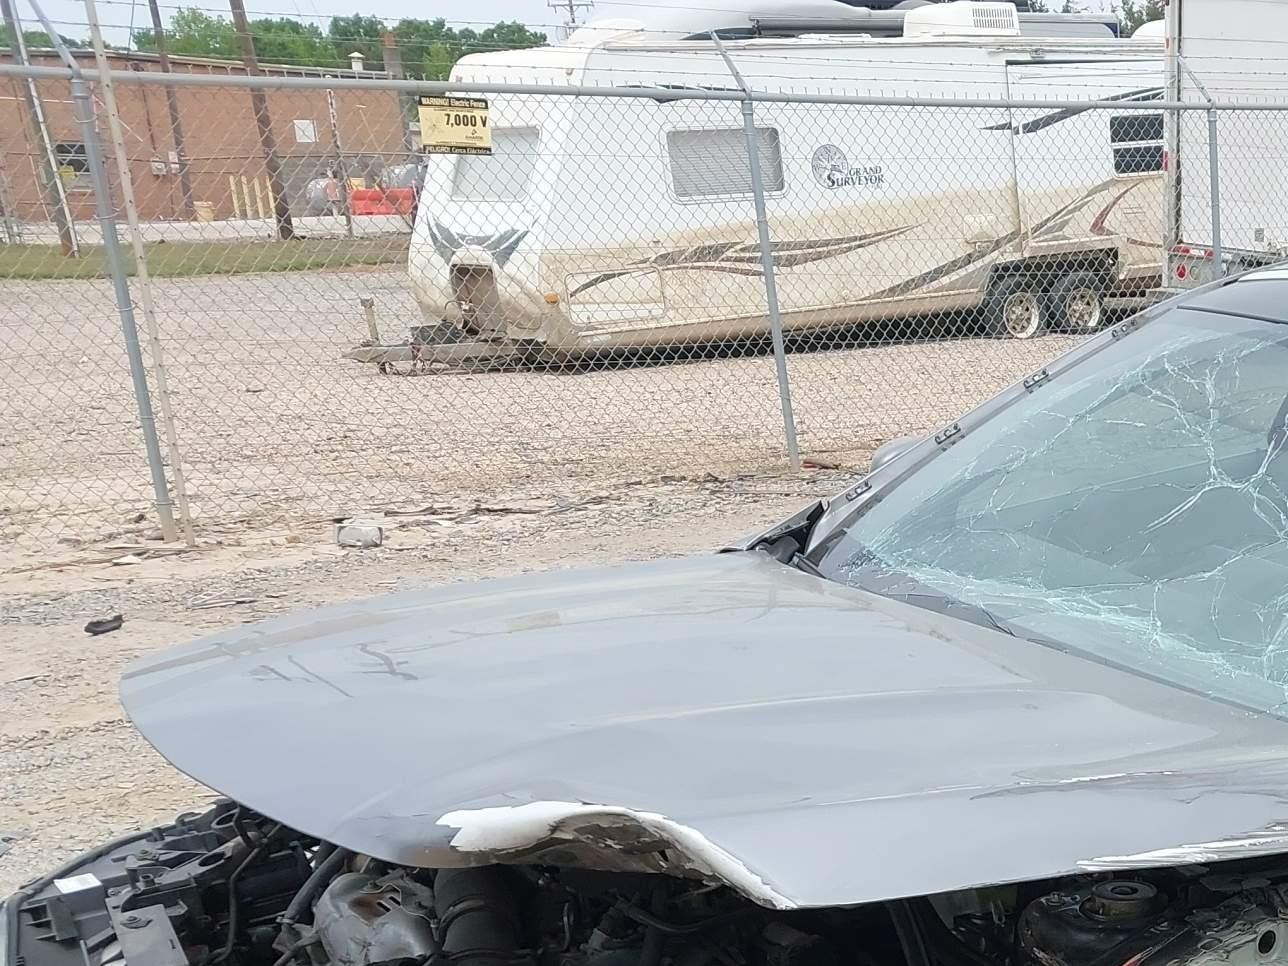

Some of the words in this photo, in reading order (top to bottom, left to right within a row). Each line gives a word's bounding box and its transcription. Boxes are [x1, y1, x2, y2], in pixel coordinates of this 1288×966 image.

[444, 113, 477, 127] 7,000
[480, 115, 488, 127] V
[849, 166, 882, 176] GRAND
[827, 173, 885, 187] SURVEYOR
